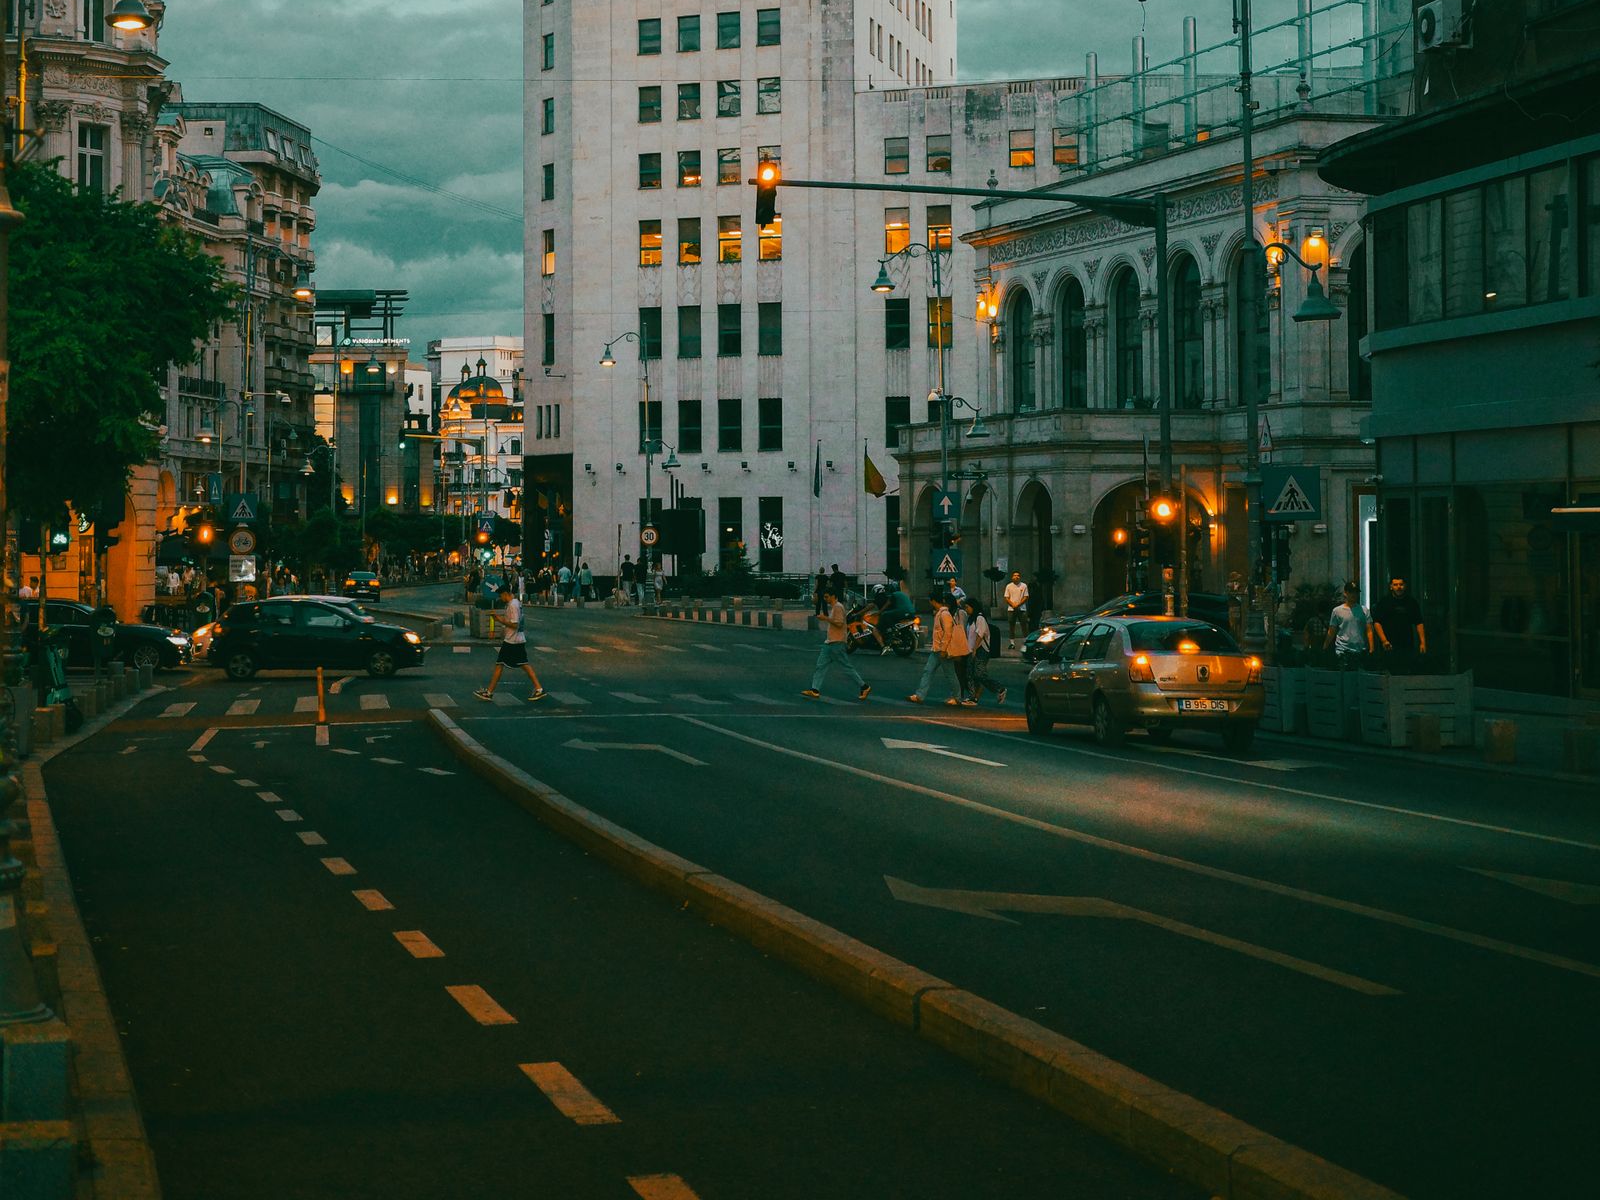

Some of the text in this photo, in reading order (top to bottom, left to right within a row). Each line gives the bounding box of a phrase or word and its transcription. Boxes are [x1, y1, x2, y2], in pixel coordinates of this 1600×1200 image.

[644, 532, 654, 540] 30
[1185, 700, 1191, 709] B
[1194, 700, 1207, 709] 915
